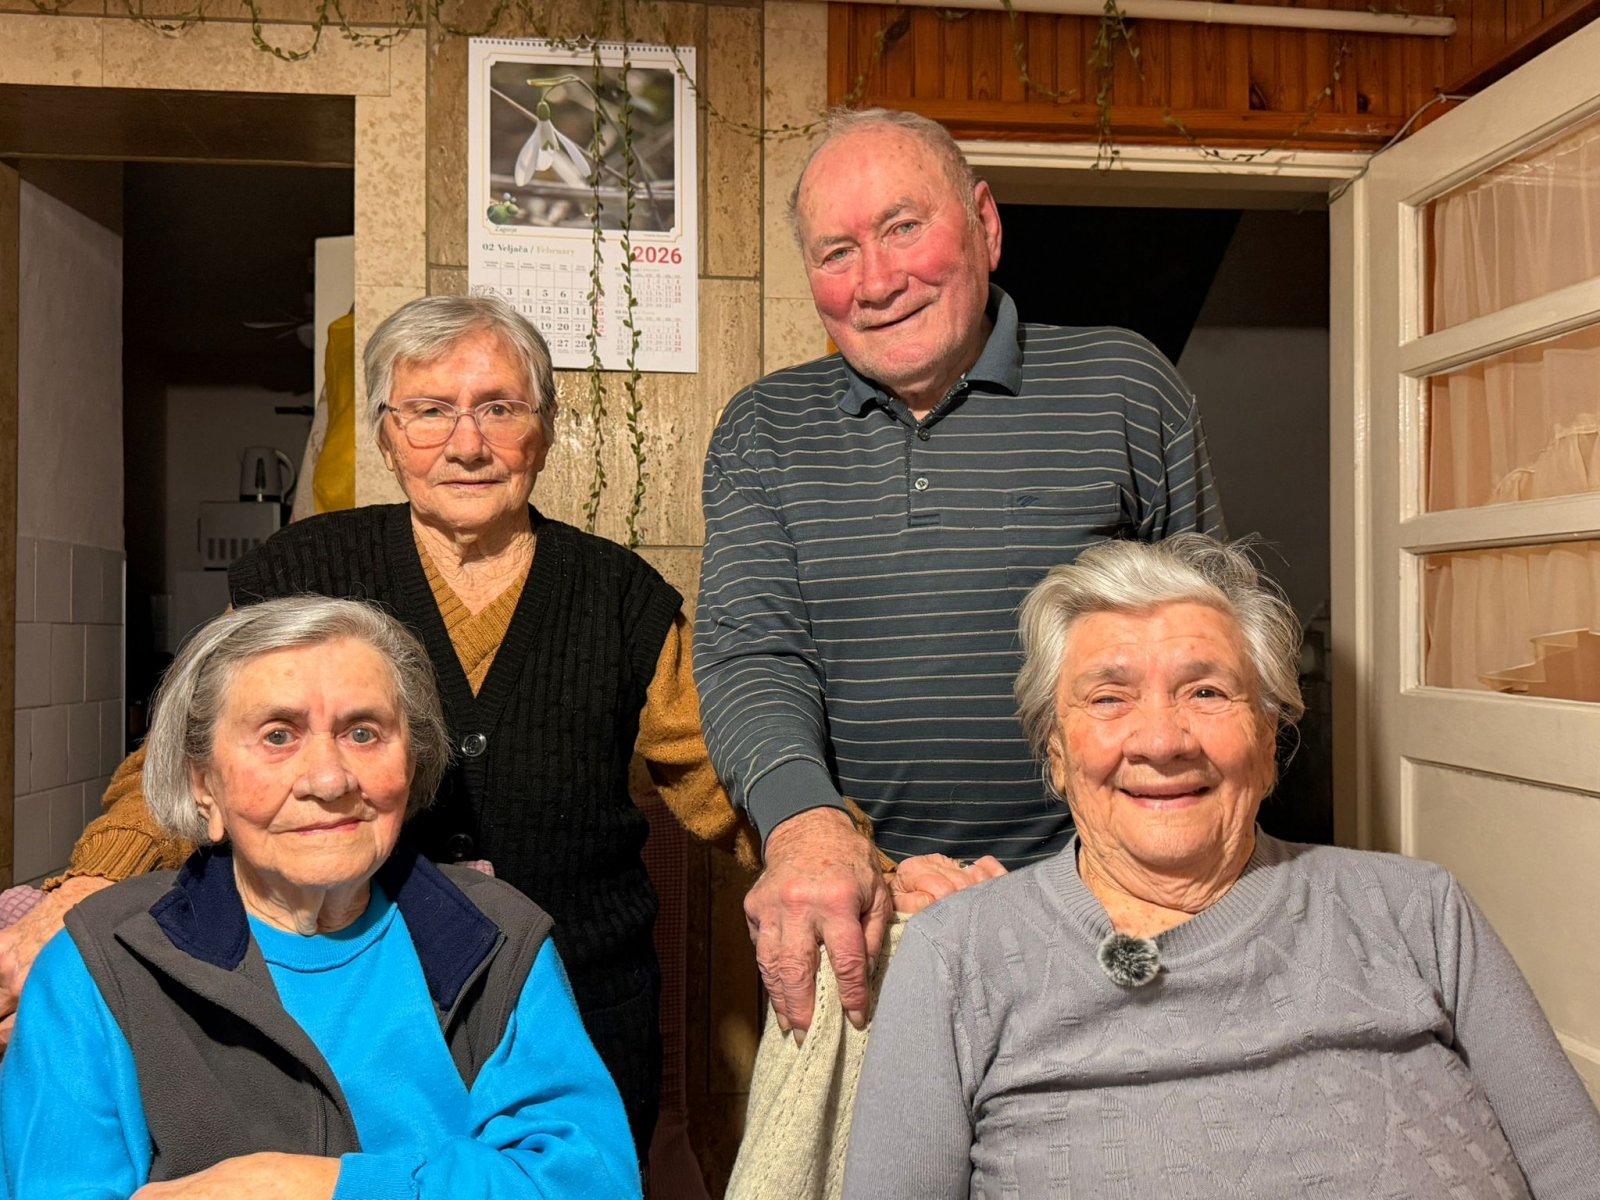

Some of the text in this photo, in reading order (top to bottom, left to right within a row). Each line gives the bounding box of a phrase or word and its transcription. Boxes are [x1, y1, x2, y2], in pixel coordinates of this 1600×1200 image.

[482, 243, 495, 251] 02
[498, 243, 528, 254] Veljača
[536, 245, 575, 256] February
[632, 246, 682, 264] 2026
[523, 305, 533, 313] 11
[541, 306, 552, 314] 12
[559, 307, 569, 315] 13
[541, 322, 552, 330] 19
[557, 323, 570, 331] 20
[574, 324, 586, 332] 21
[557, 340, 569, 348] 27
[574, 340, 587, 348] 28
